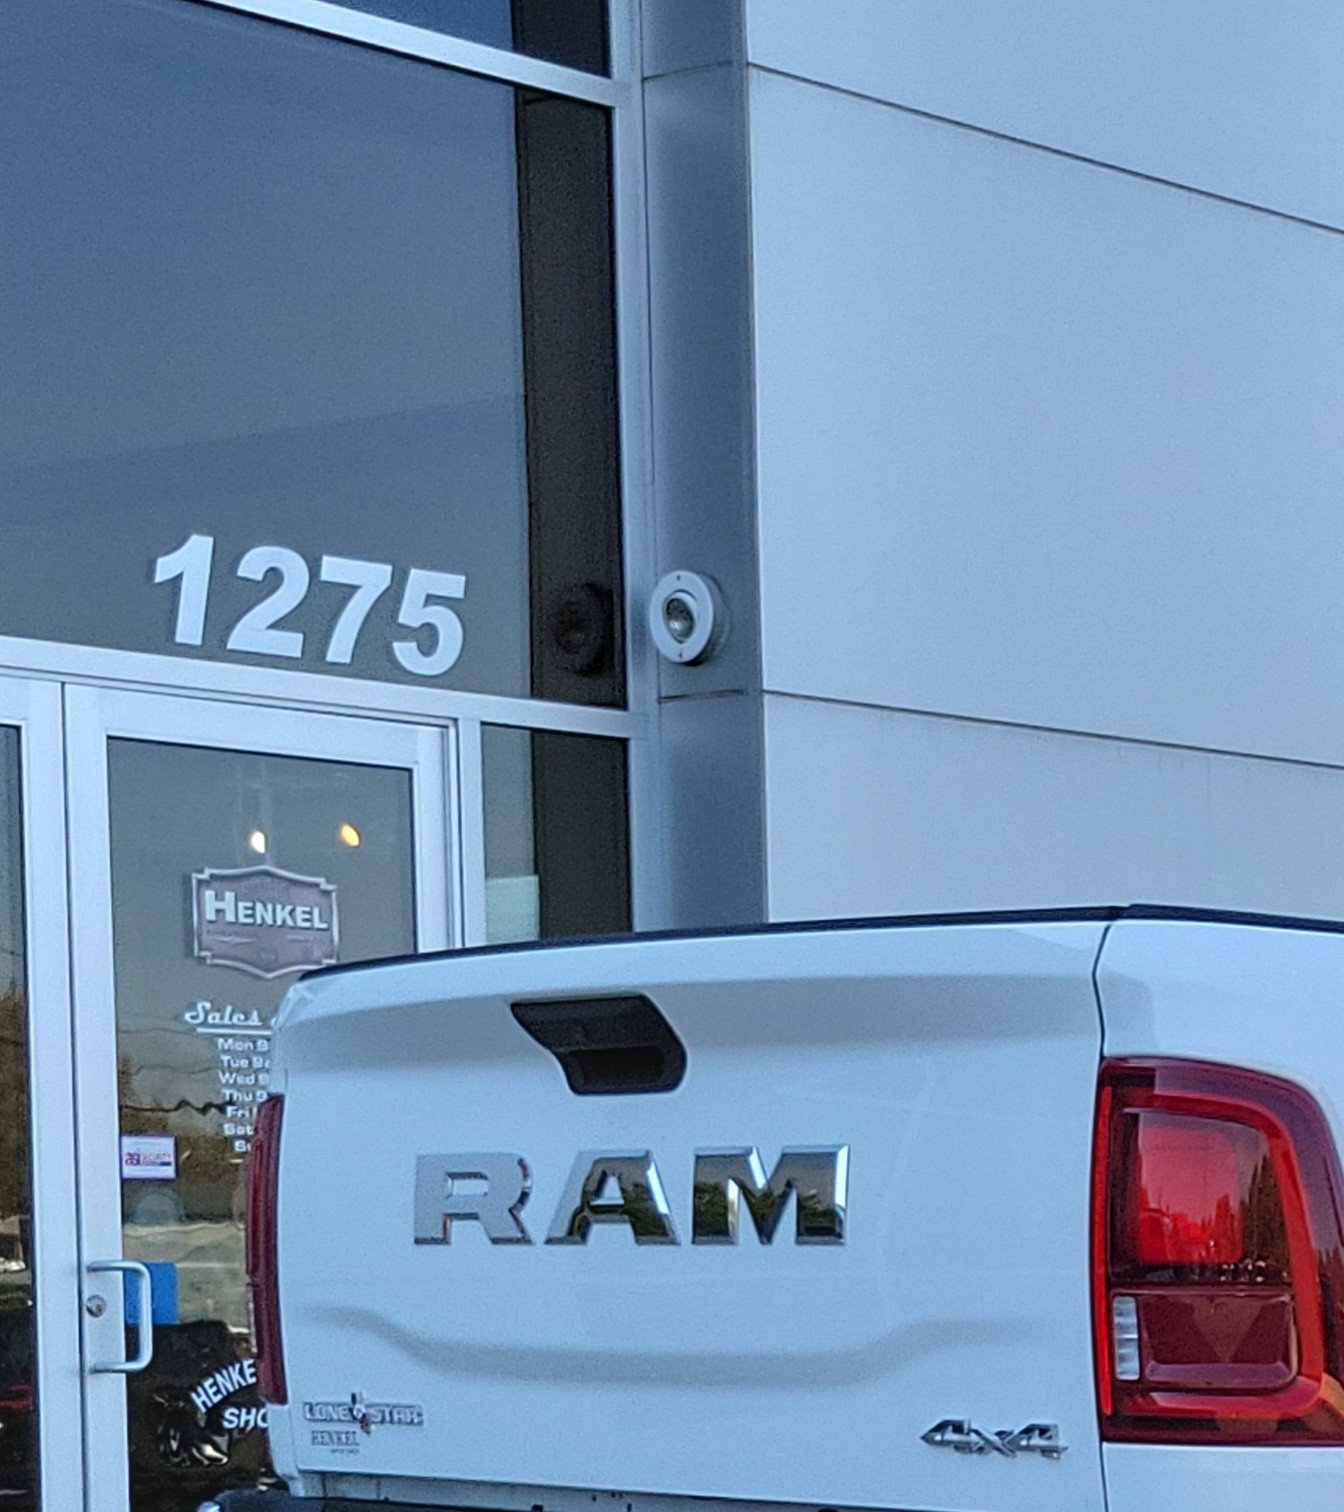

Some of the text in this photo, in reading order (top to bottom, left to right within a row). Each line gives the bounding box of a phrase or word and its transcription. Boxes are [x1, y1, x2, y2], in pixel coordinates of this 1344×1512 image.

[153, 533, 466, 677] 1275
[203, 889, 329, 930] HENKEL
[184, 1001, 263, 1026] Sales
[217, 1038, 254, 1051] Mon
[220, 1055, 249, 1068] Tue
[218, 1072, 256, 1085] Wed
[221, 1089, 253, 1101] Thu
[226, 1106, 250, 1118] Fri
[414, 1144, 850, 1246] RAM
